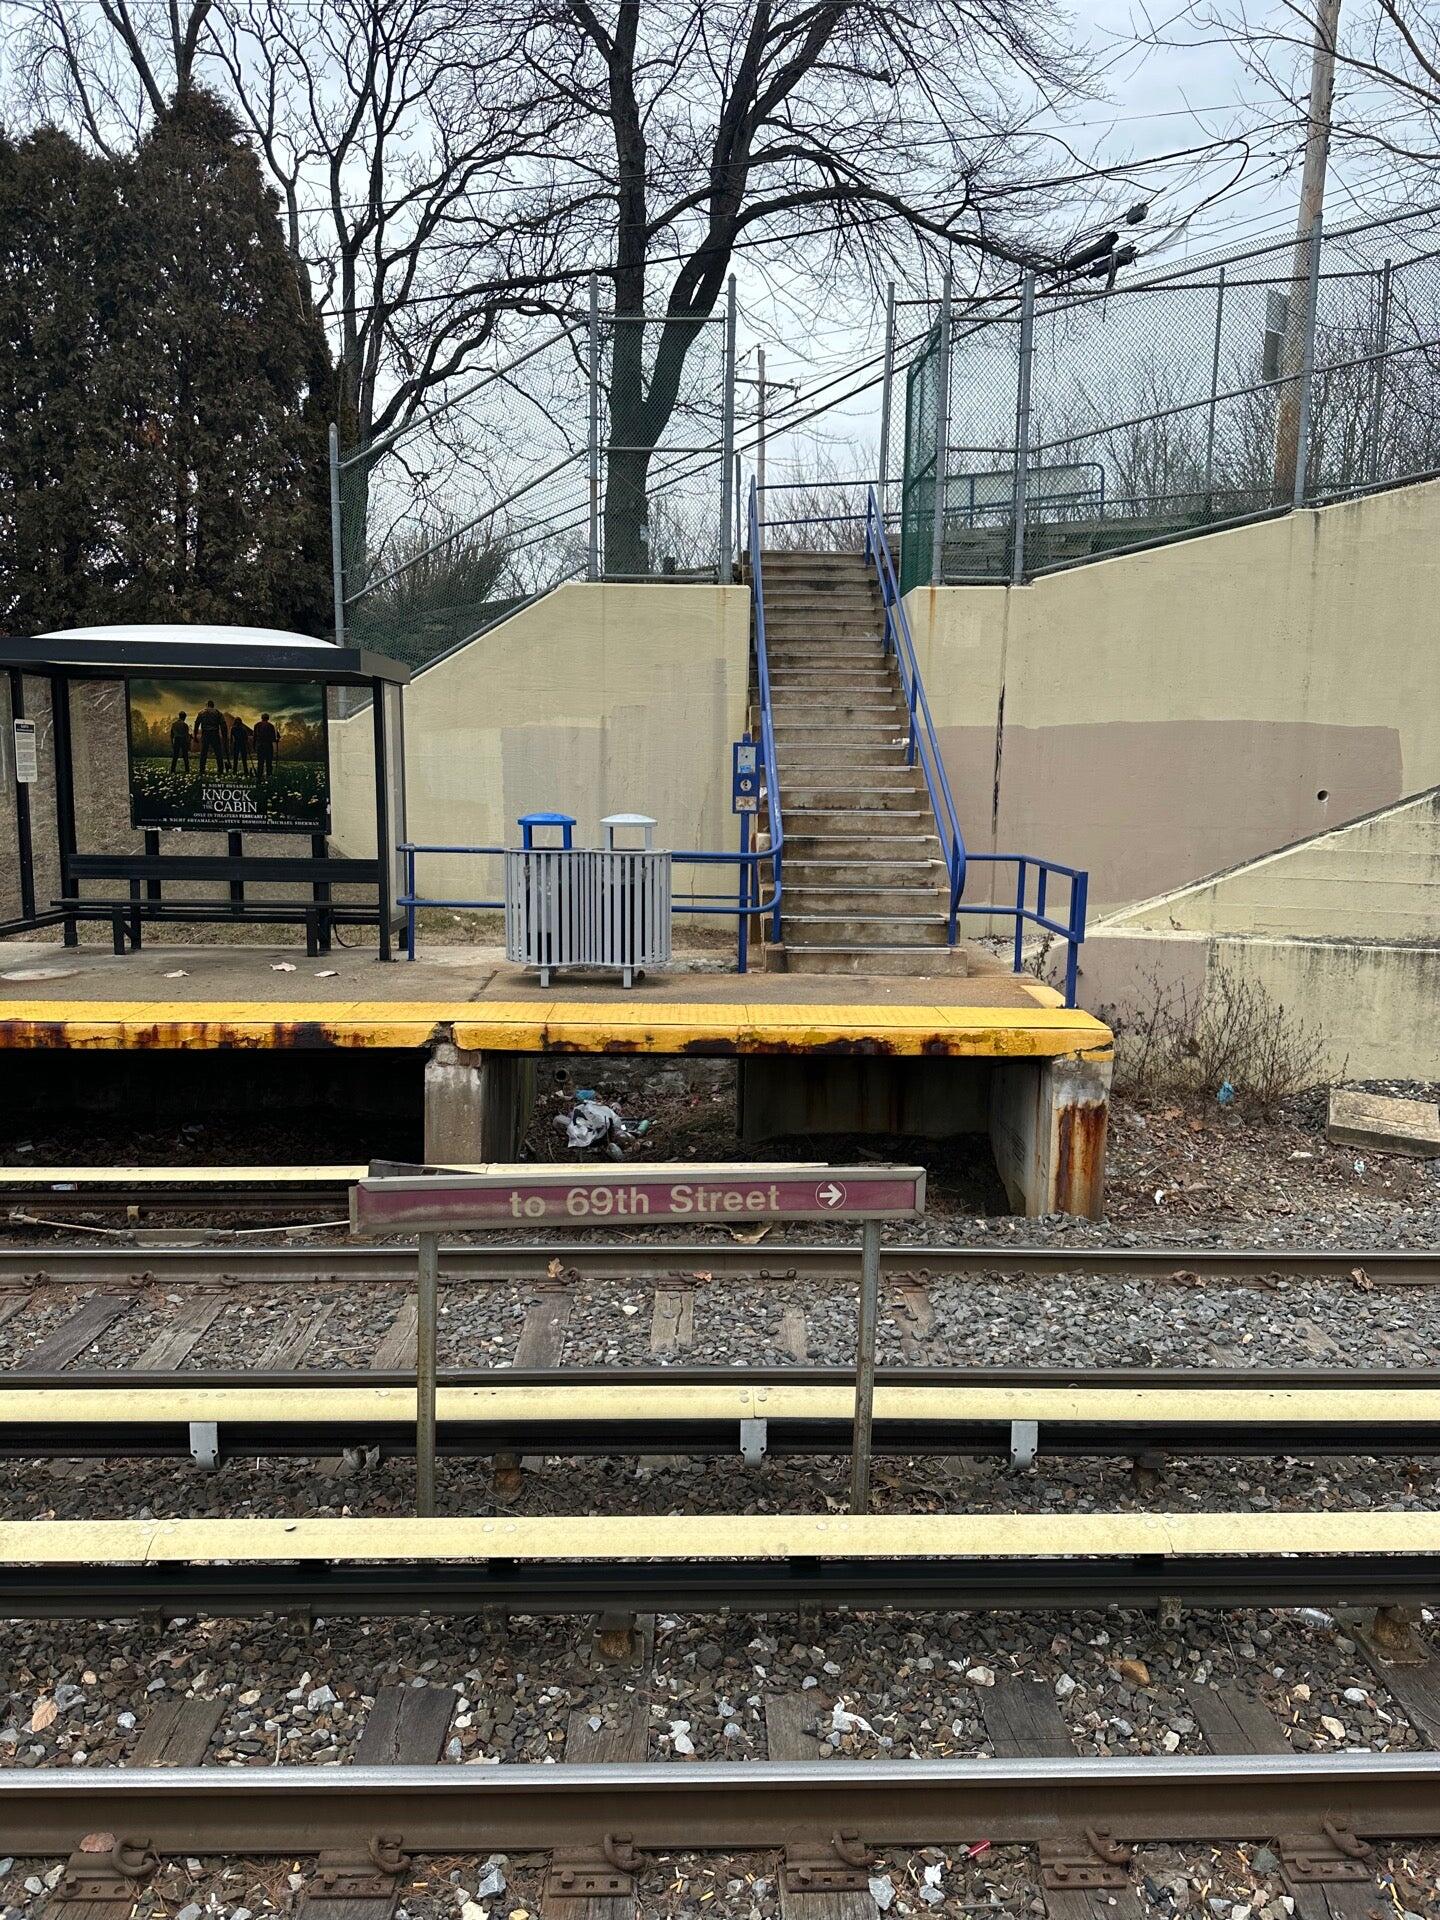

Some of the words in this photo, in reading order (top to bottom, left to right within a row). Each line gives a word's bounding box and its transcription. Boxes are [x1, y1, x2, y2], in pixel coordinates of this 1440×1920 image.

[201, 788, 251, 802] KNOCK
[213, 800, 258, 813] CABIN
[509, 1191, 546, 1218] to
[566, 1186, 649, 1216] 69th
[669, 1184, 780, 1213] Street
